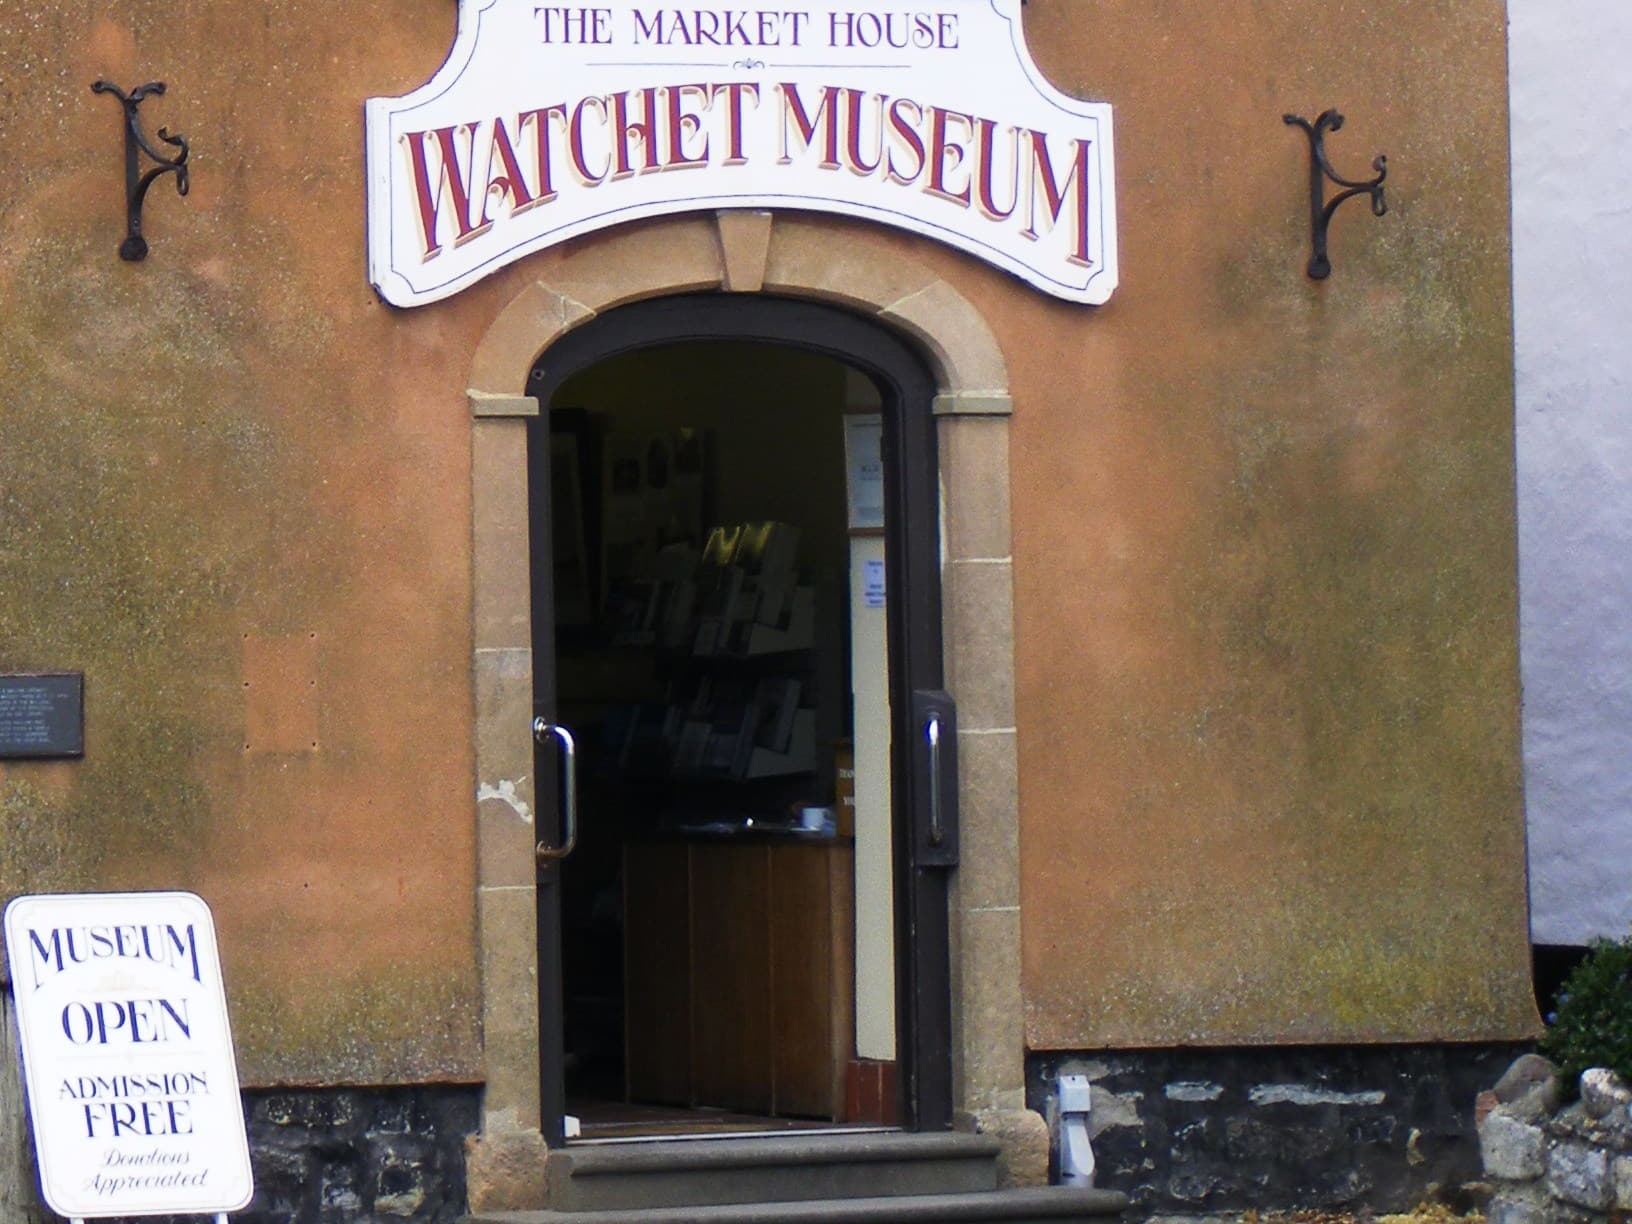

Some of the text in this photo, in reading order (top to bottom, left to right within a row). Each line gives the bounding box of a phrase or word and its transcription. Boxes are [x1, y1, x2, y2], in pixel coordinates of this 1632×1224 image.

[534, 7, 960, 50] THE MARKET HOUSE
[397, 82, 1096, 269] WATCHET MUSEUM
[28, 924, 206, 992] MUSEUM
[61, 998, 193, 1045] OPEN
[58, 1072, 211, 1100] ADMISSION
[83, 1099, 193, 1138] FREE
[102, 1148, 191, 1169] Donations
[84, 1169, 209, 1196] Appreciated
